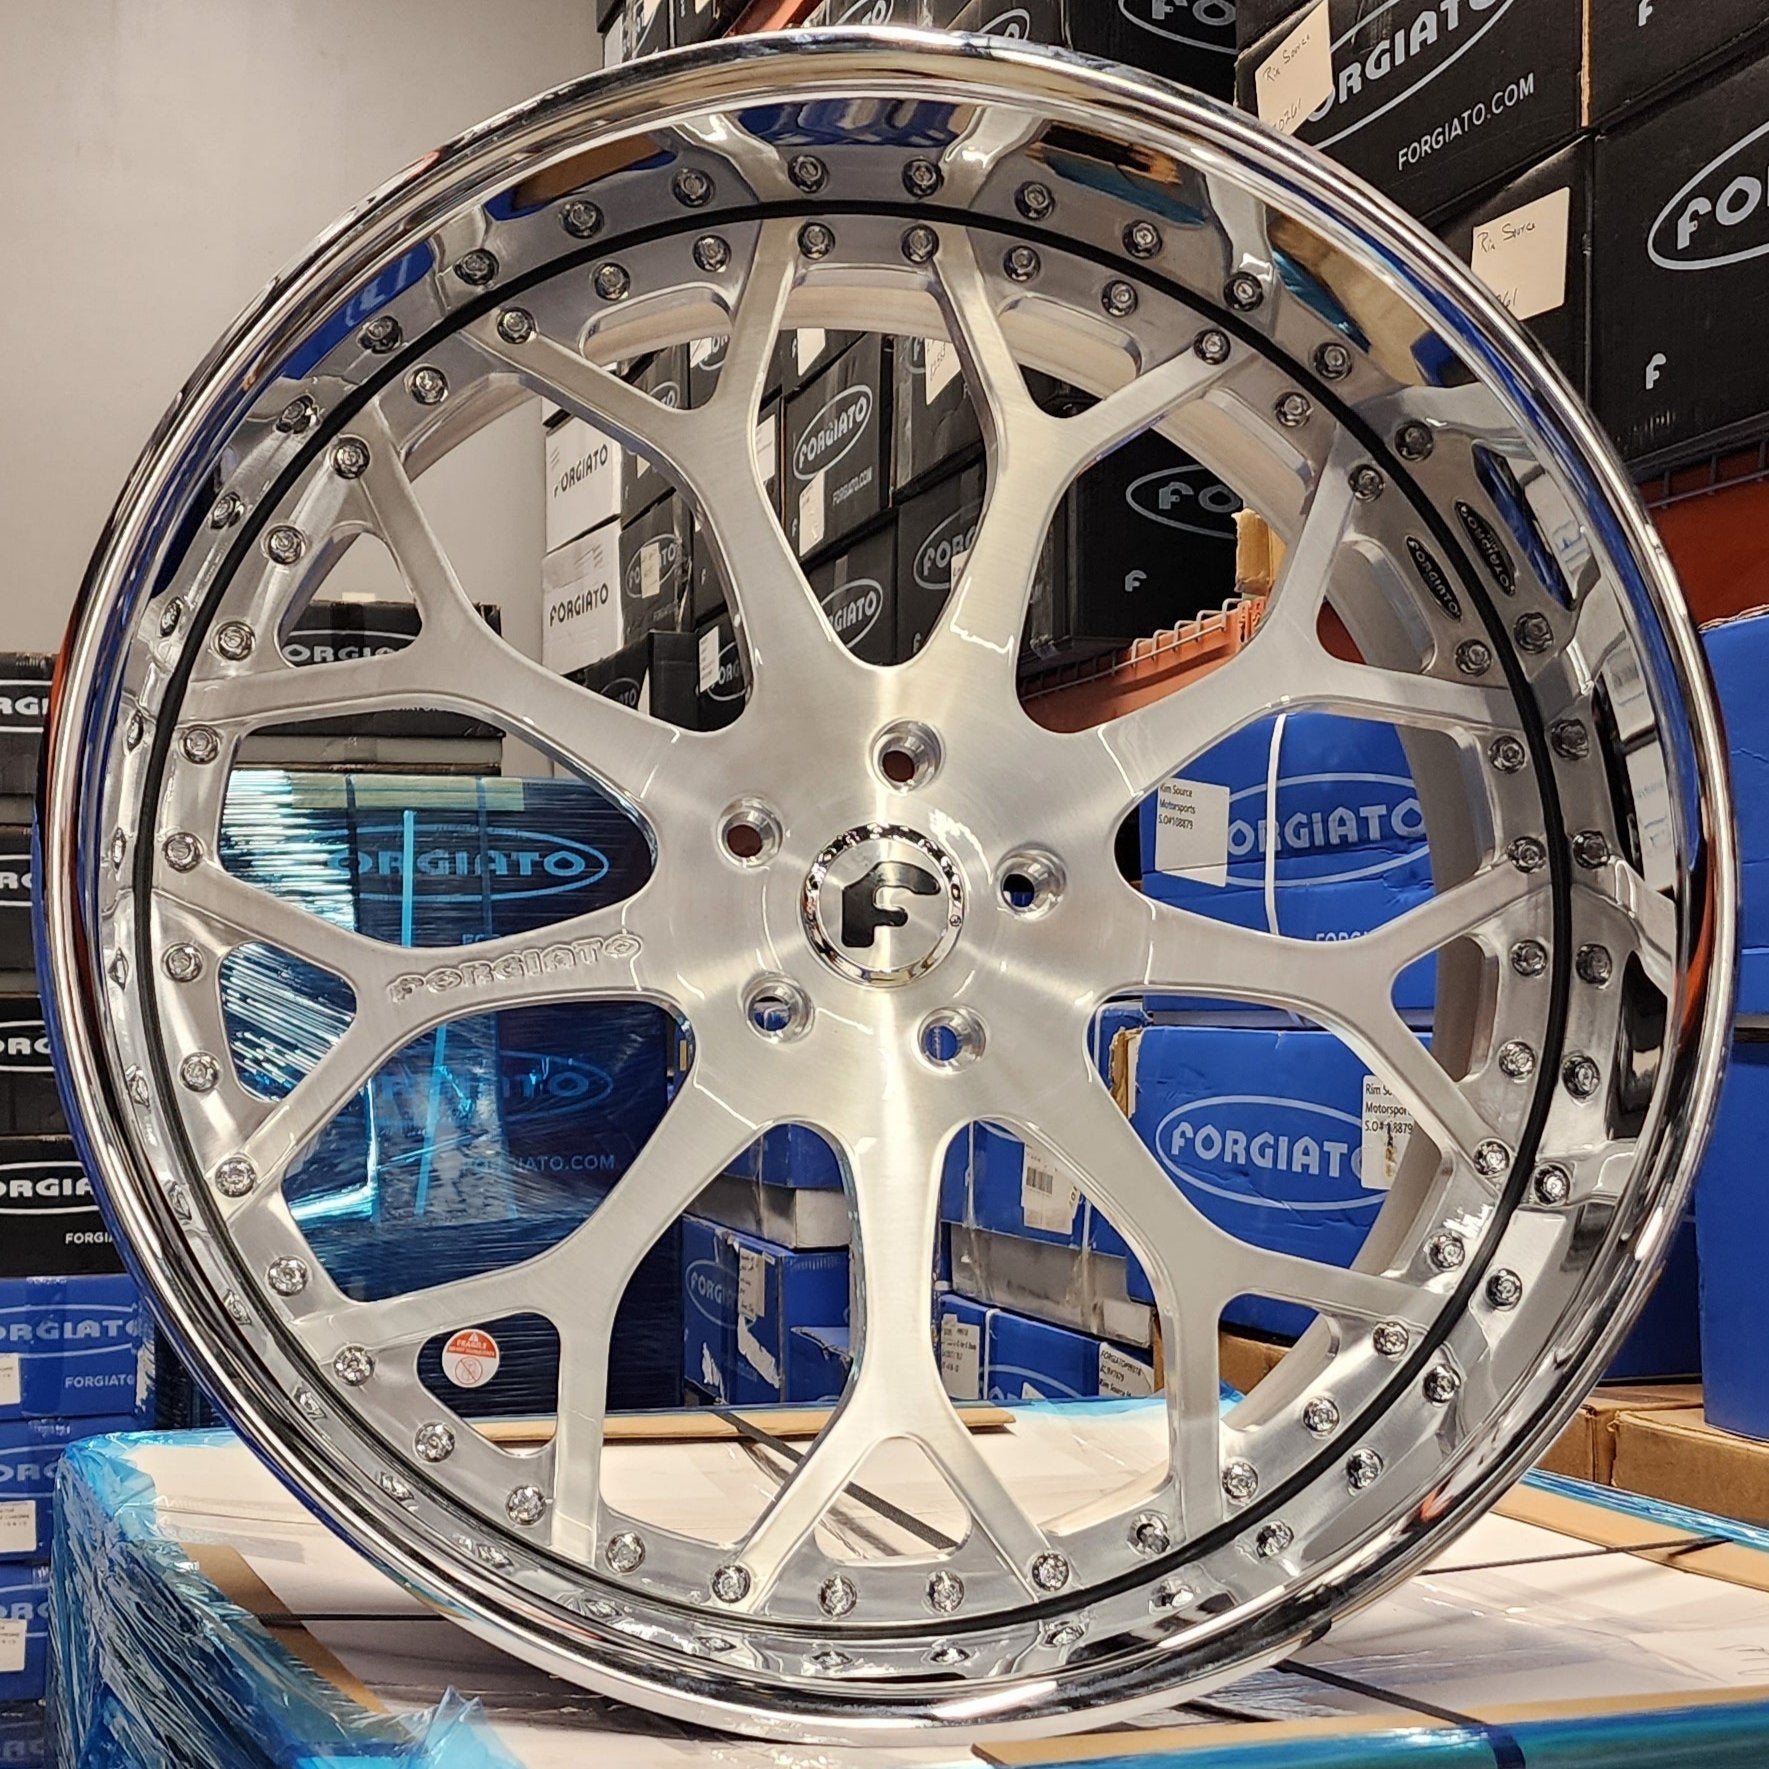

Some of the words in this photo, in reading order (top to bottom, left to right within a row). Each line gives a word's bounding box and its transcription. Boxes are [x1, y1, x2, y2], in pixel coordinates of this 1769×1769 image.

[1398, 72, 1535, 171] FORGIATO.COM
[1676, 165, 1769, 251] FO
[798, 395, 868, 469] FORGIATO
[549, 582, 609, 627] FORGIATO
[386, 932, 642, 1004] FORGIATO
